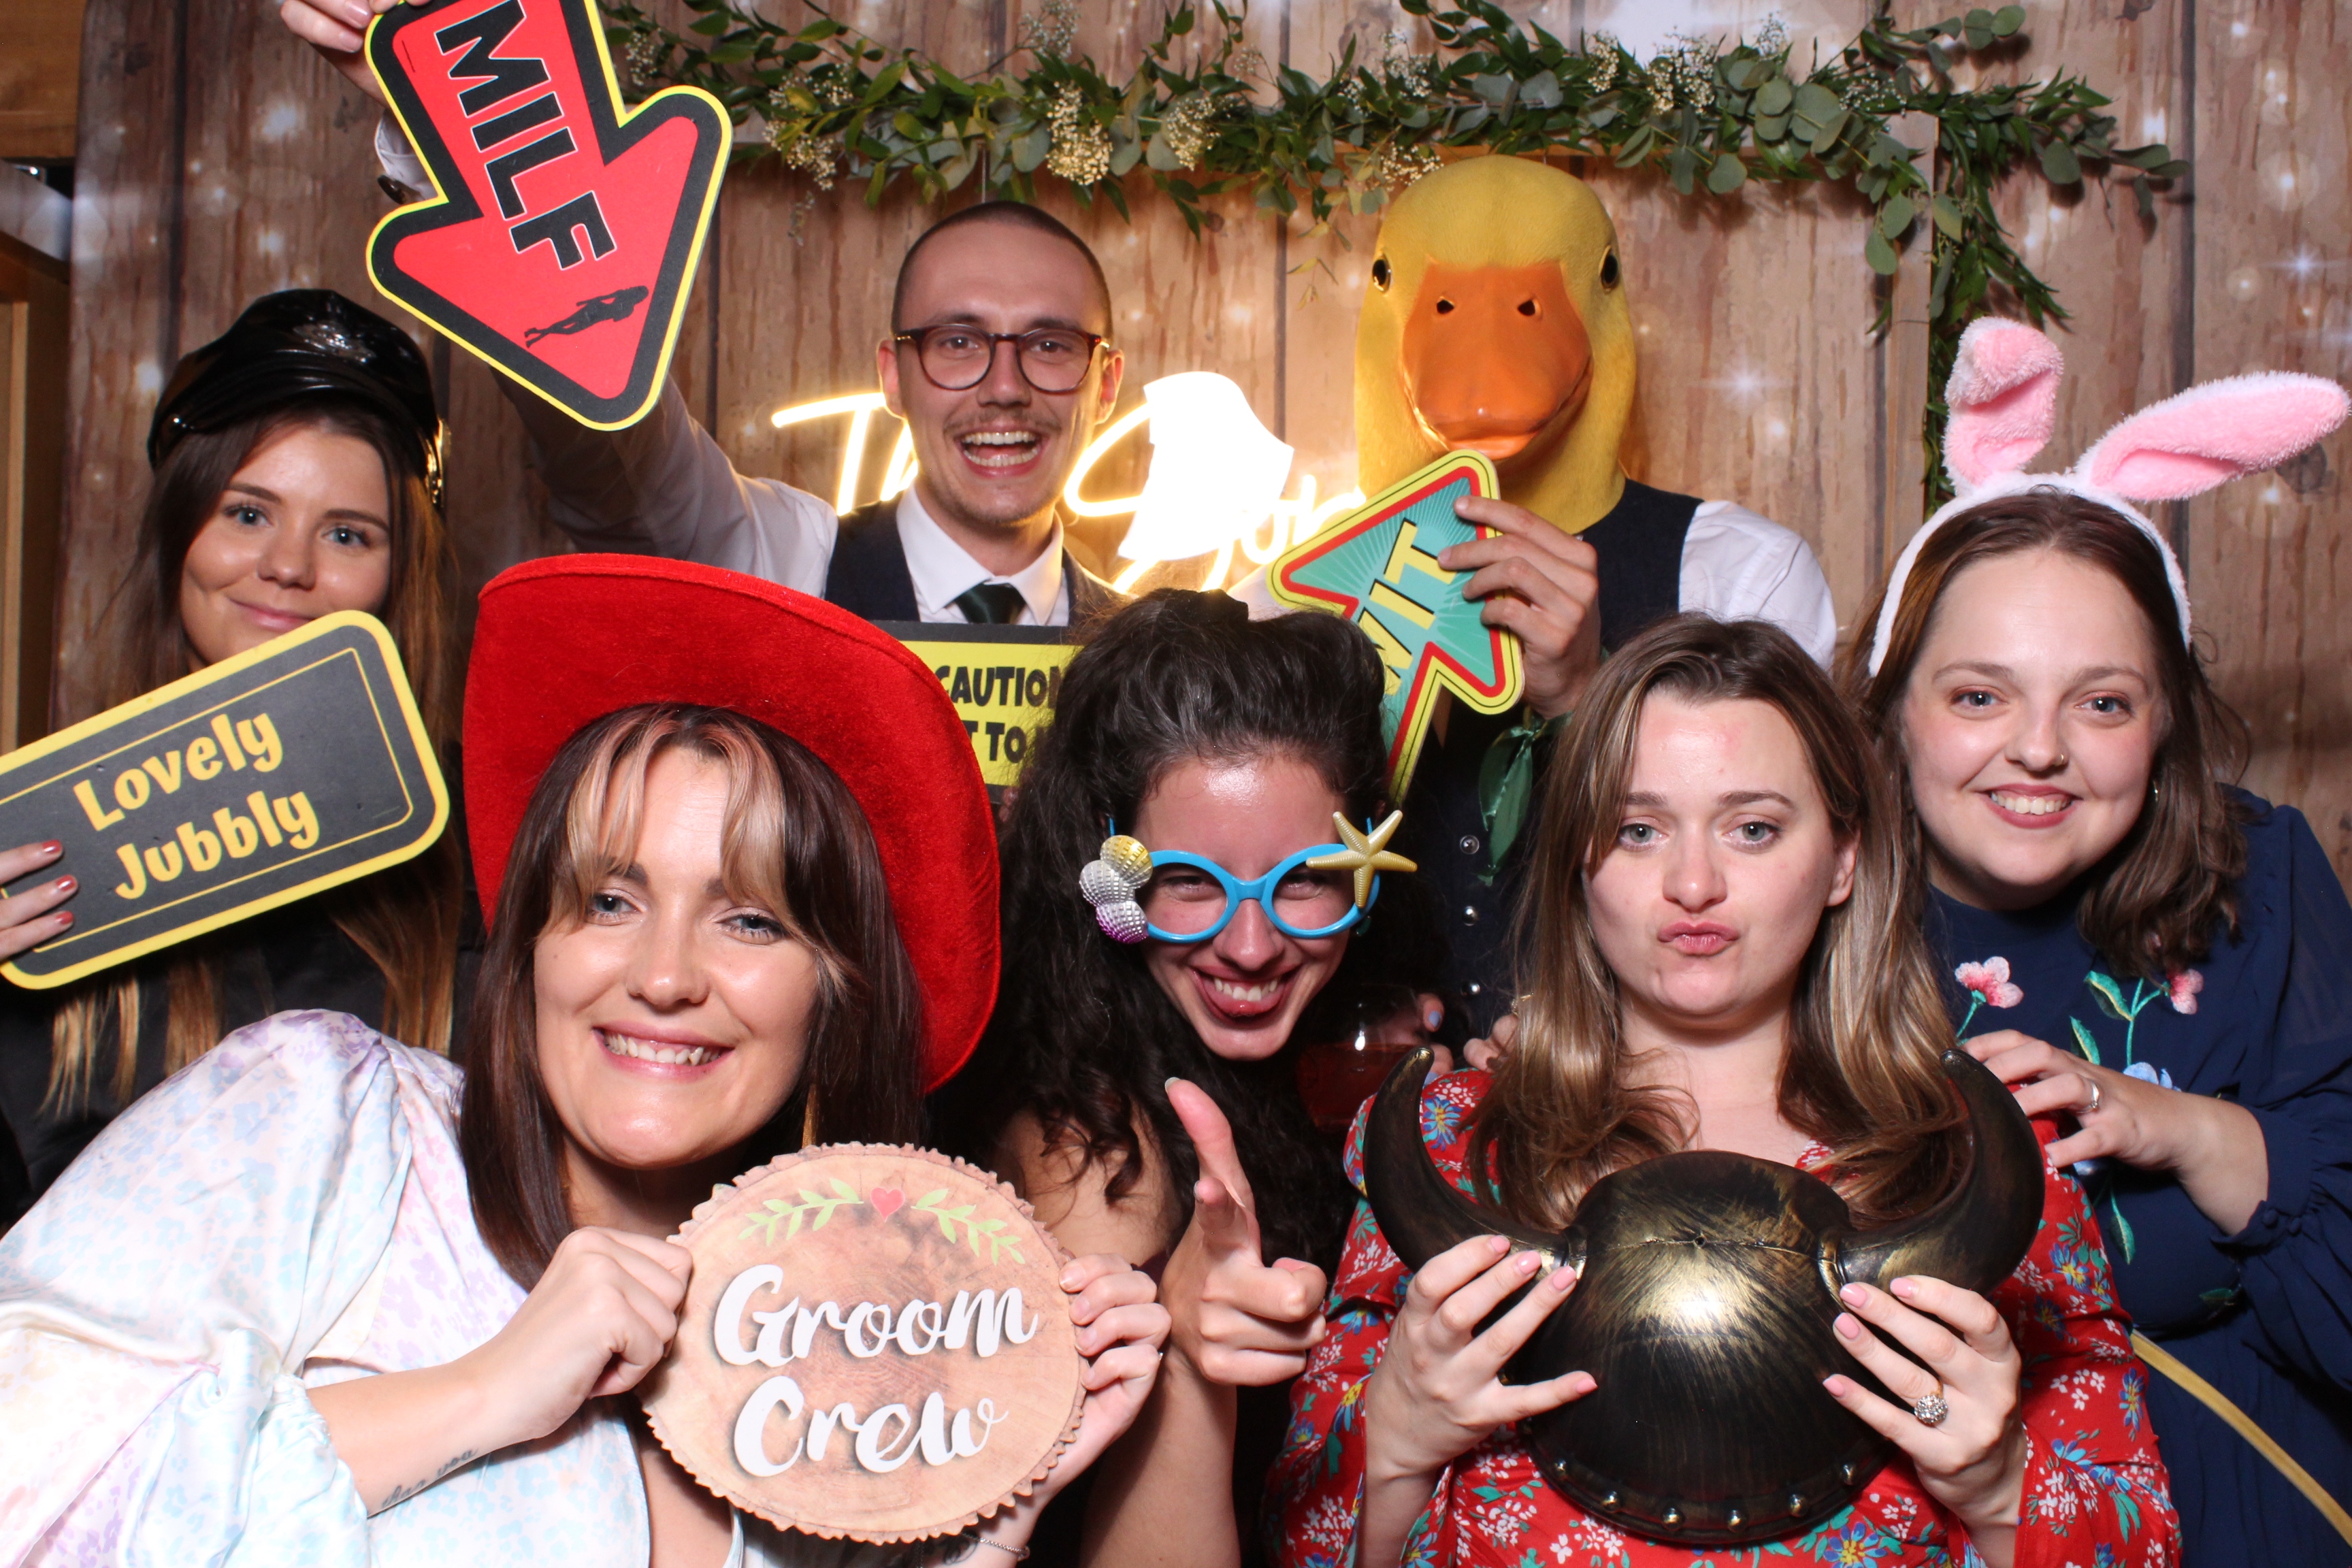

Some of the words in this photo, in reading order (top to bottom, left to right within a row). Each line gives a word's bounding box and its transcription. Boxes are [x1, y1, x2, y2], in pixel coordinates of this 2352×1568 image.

[434, 0, 617, 271] MILF
[73, 713, 282, 832] Lovely
[985, 721, 1027, 764] TO
[114, 790, 321, 900] Jubbly
[713, 1264, 1039, 1368] Groom
[733, 1375, 1009, 1477] Crew
